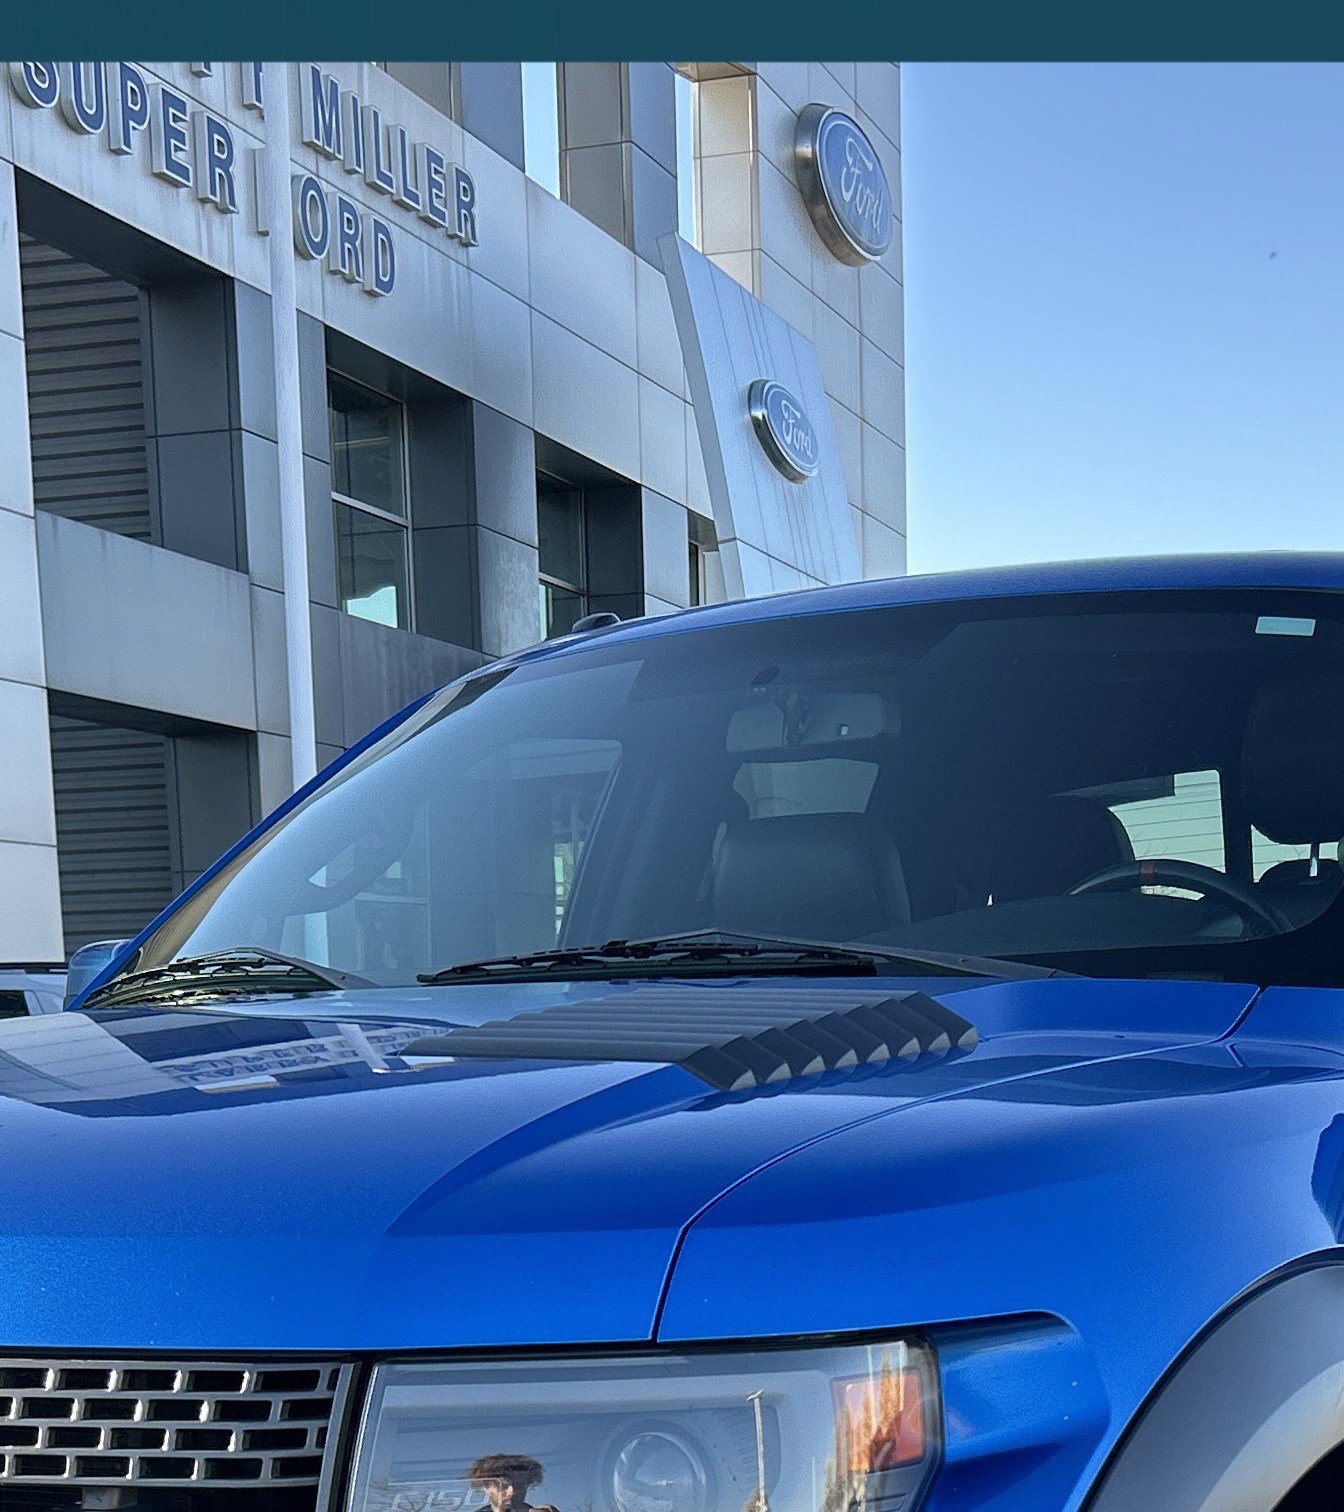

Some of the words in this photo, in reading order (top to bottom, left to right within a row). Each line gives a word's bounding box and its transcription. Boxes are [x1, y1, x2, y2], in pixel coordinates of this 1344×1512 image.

[304, 64, 478, 246] MILLER
[839, 136, 883, 236] Ford
[780, 398, 814, 461] Ford
